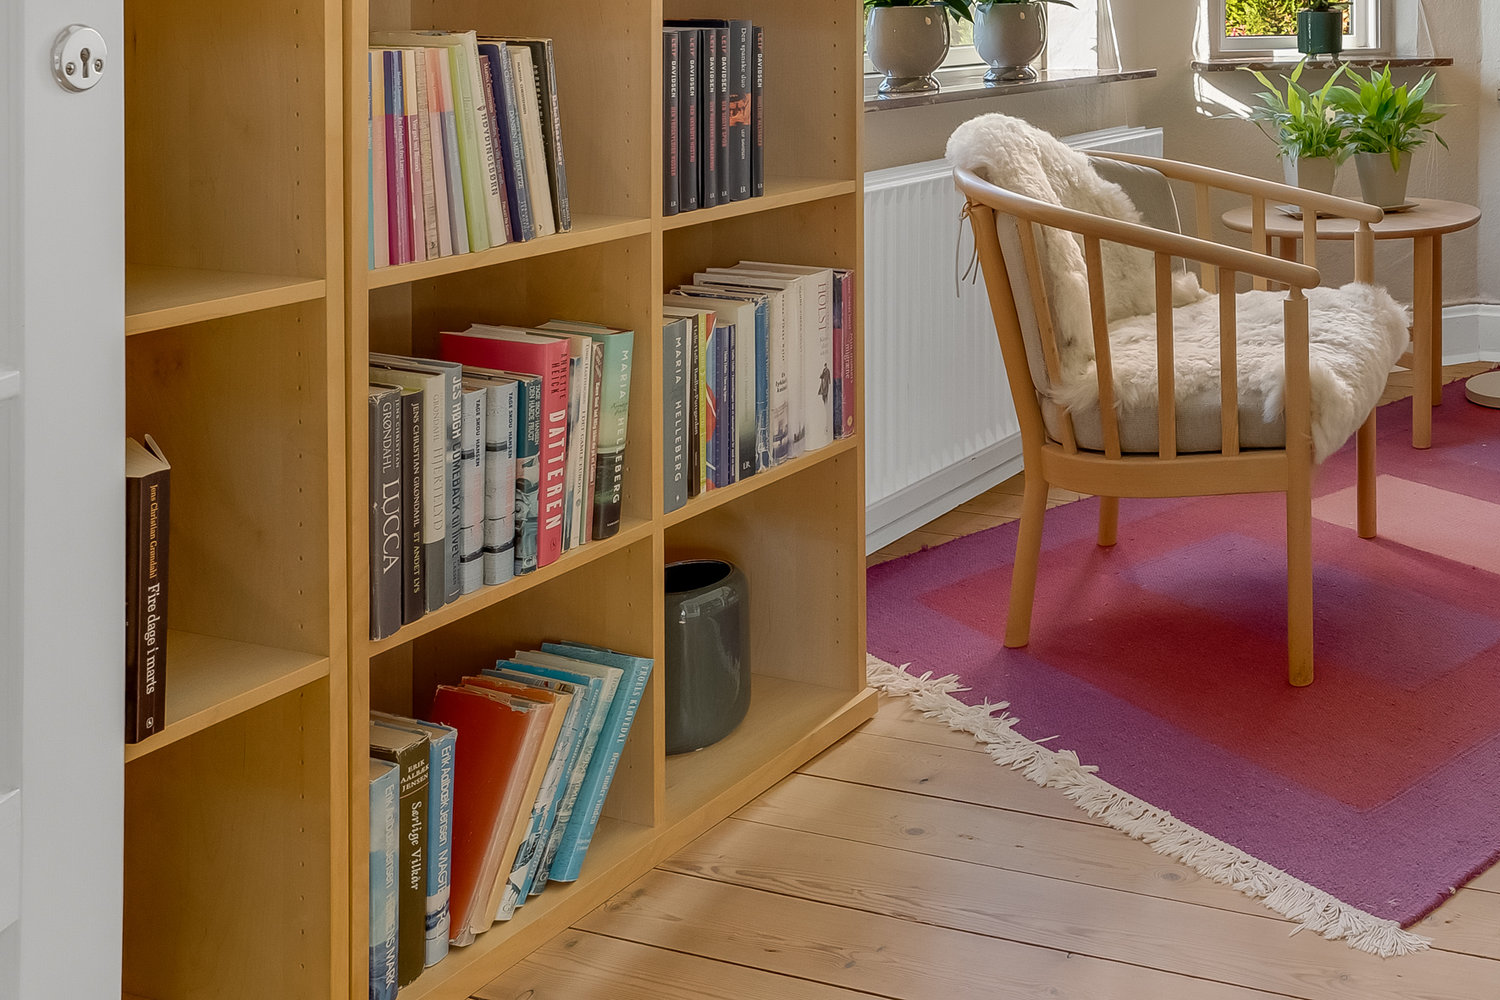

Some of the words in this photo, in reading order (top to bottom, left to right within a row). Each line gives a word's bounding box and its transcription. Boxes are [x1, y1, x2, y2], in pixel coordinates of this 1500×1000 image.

[738, 44, 748, 74] spanske
[740, 74, 748, 88] duo
[559, 352, 568, 400] ANNETTE
[619, 350, 630, 400] MARIA
[674, 336, 682, 385] MARIA
[452, 376, 462, 400] JES
[528, 385, 536, 398] DEN
[550, 362, 560, 394] HEICK
[411, 403, 420, 423] JENS
[452, 402, 462, 439] HØGH
[382, 402, 392, 474] GRØNDAHL
[412, 424, 420, 475] CHRISTIAN
[674, 400, 682, 482] HELLEBERG
[545, 409, 566, 530] DATTEREN
[612, 417, 625, 504] HELLEBERG
[150, 484, 158, 502] Jens
[452, 442, 462, 514] COMEBACK
[412, 476, 420, 528] GRØNDAHL
[150, 502, 159, 540] Christian
[380, 478, 400, 574] LUCCA
[452, 514, 461, 530] til
[412, 532, 420, 544] ET
[452, 531, 461, 559] livet
[412, 546, 420, 576] ANDET
[147, 582, 160, 612] Fire
[144, 614, 160, 646] dage
[146, 655, 158, 696] marts
[632, 664, 650, 696] TROELS
[616, 700, 638, 744] KLØVEDAL
[407, 758, 425, 772] ERIK
[441, 745, 452, 766] Erik
[402, 772, 429, 792] JENSEN
[598, 775, 613, 797] under
[440, 808, 450, 846] Jensen
[590, 798, 603, 825] vinden
[411, 848, 422, 890] Vilkår
[384, 948, 396, 989] MARK
